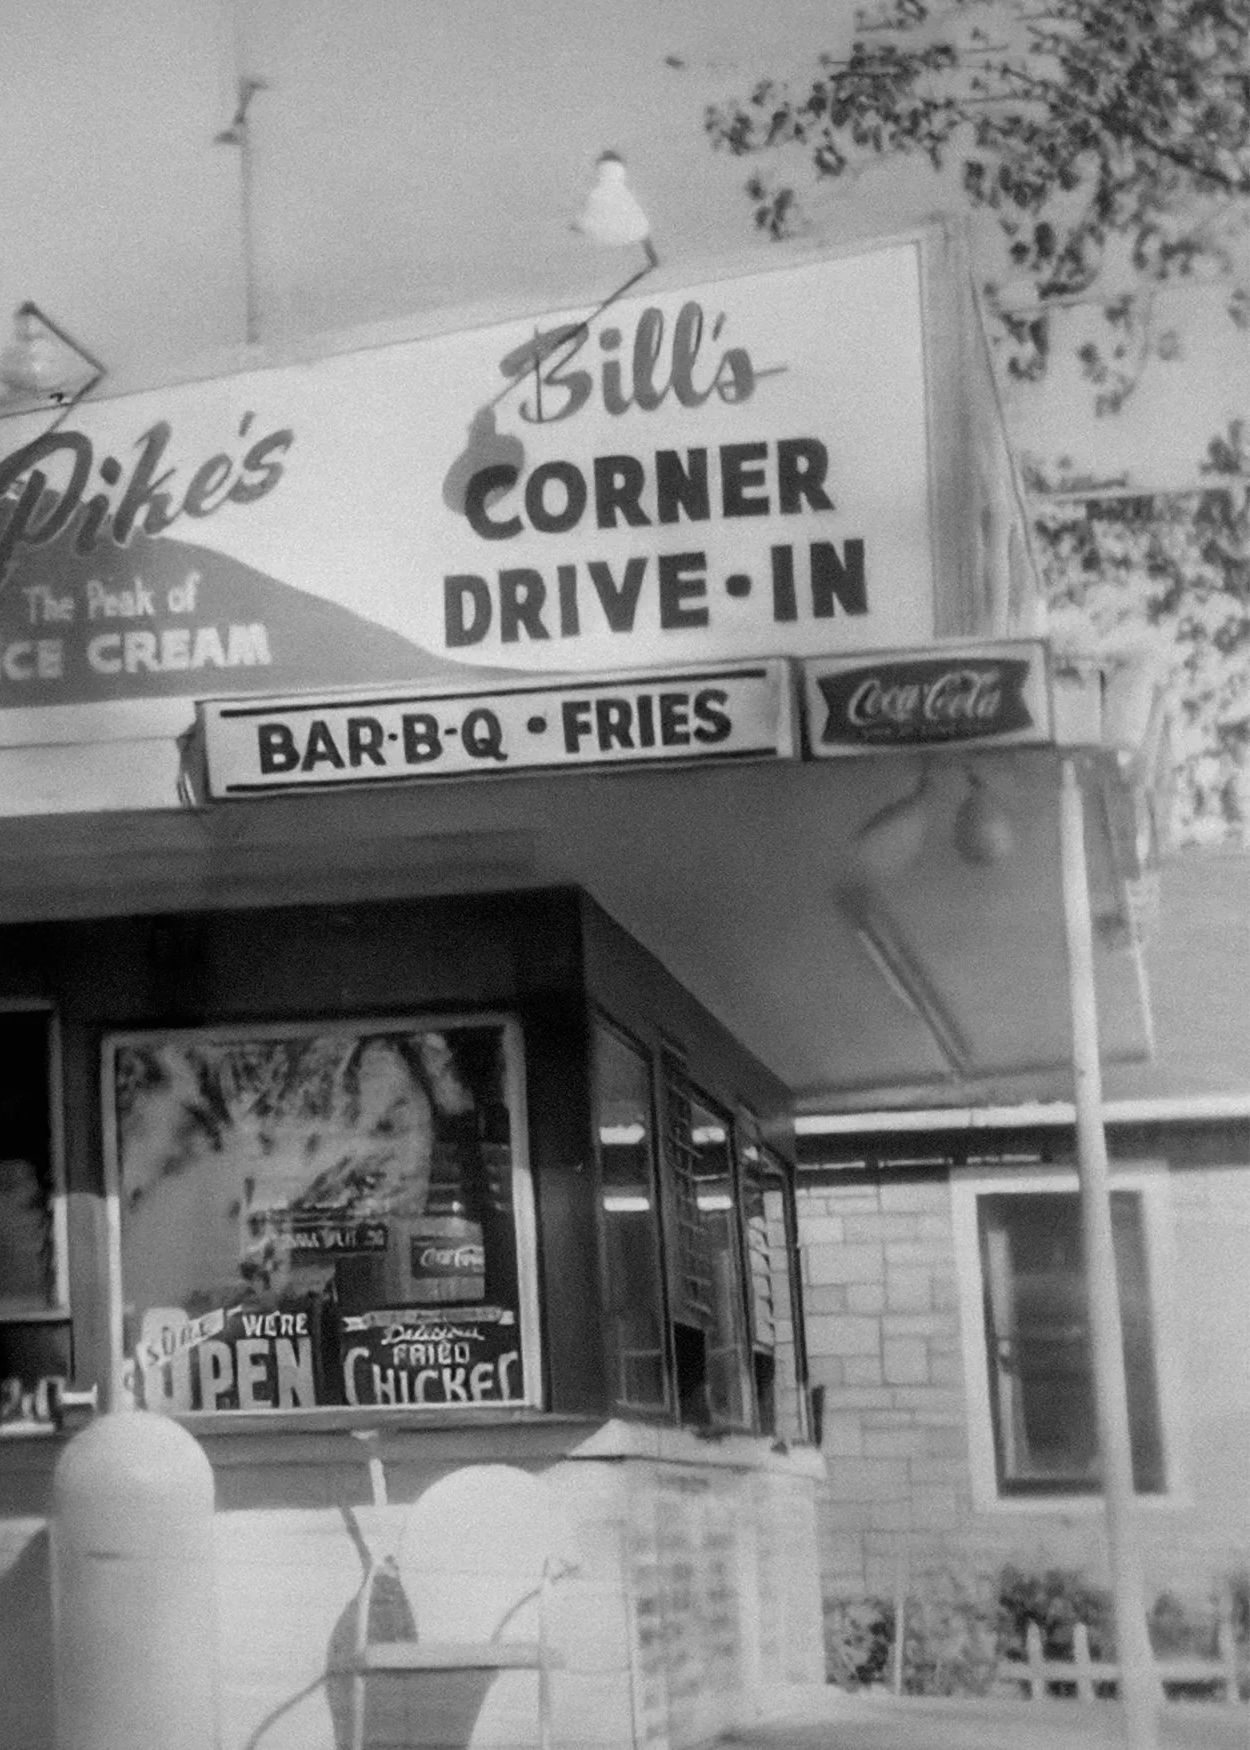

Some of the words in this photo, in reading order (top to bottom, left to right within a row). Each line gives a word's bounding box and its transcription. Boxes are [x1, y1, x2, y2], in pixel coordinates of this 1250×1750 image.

[498, 301, 788, 424] Bill's
[465, 438, 835, 540] CORNER
[23, 586, 74, 625] The
[87, 571, 154, 620] Peak
[168, 568, 201, 614] of
[87, 624, 272, 674] CREAM
[561, 689, 732, 754] FRIES
[142, 1307, 317, 1411] OPEN
[393, 1340, 470, 1366] FRIED
